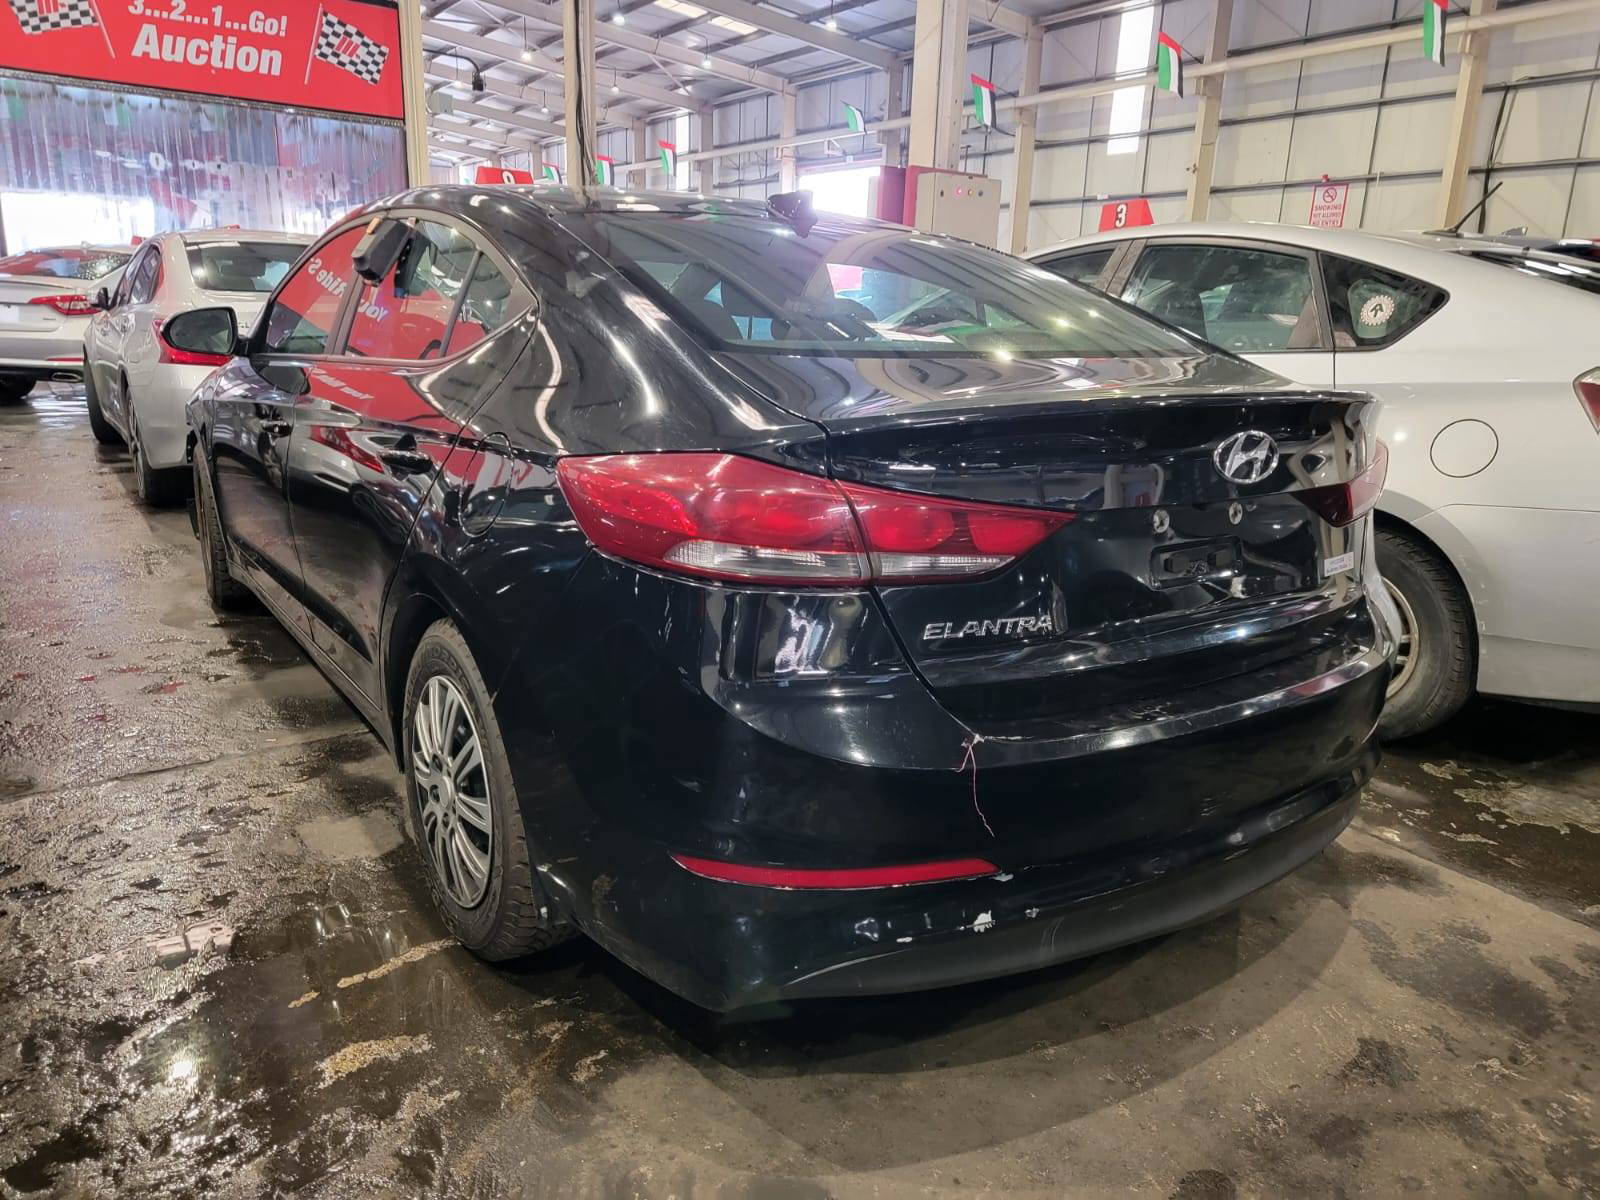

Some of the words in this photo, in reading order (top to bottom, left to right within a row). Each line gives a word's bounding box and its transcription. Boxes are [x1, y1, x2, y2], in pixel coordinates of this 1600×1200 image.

[131, 23, 282, 76] Auction
[1115, 203, 1127, 228] 3
[923, 615, 1053, 640] ELANTRA
